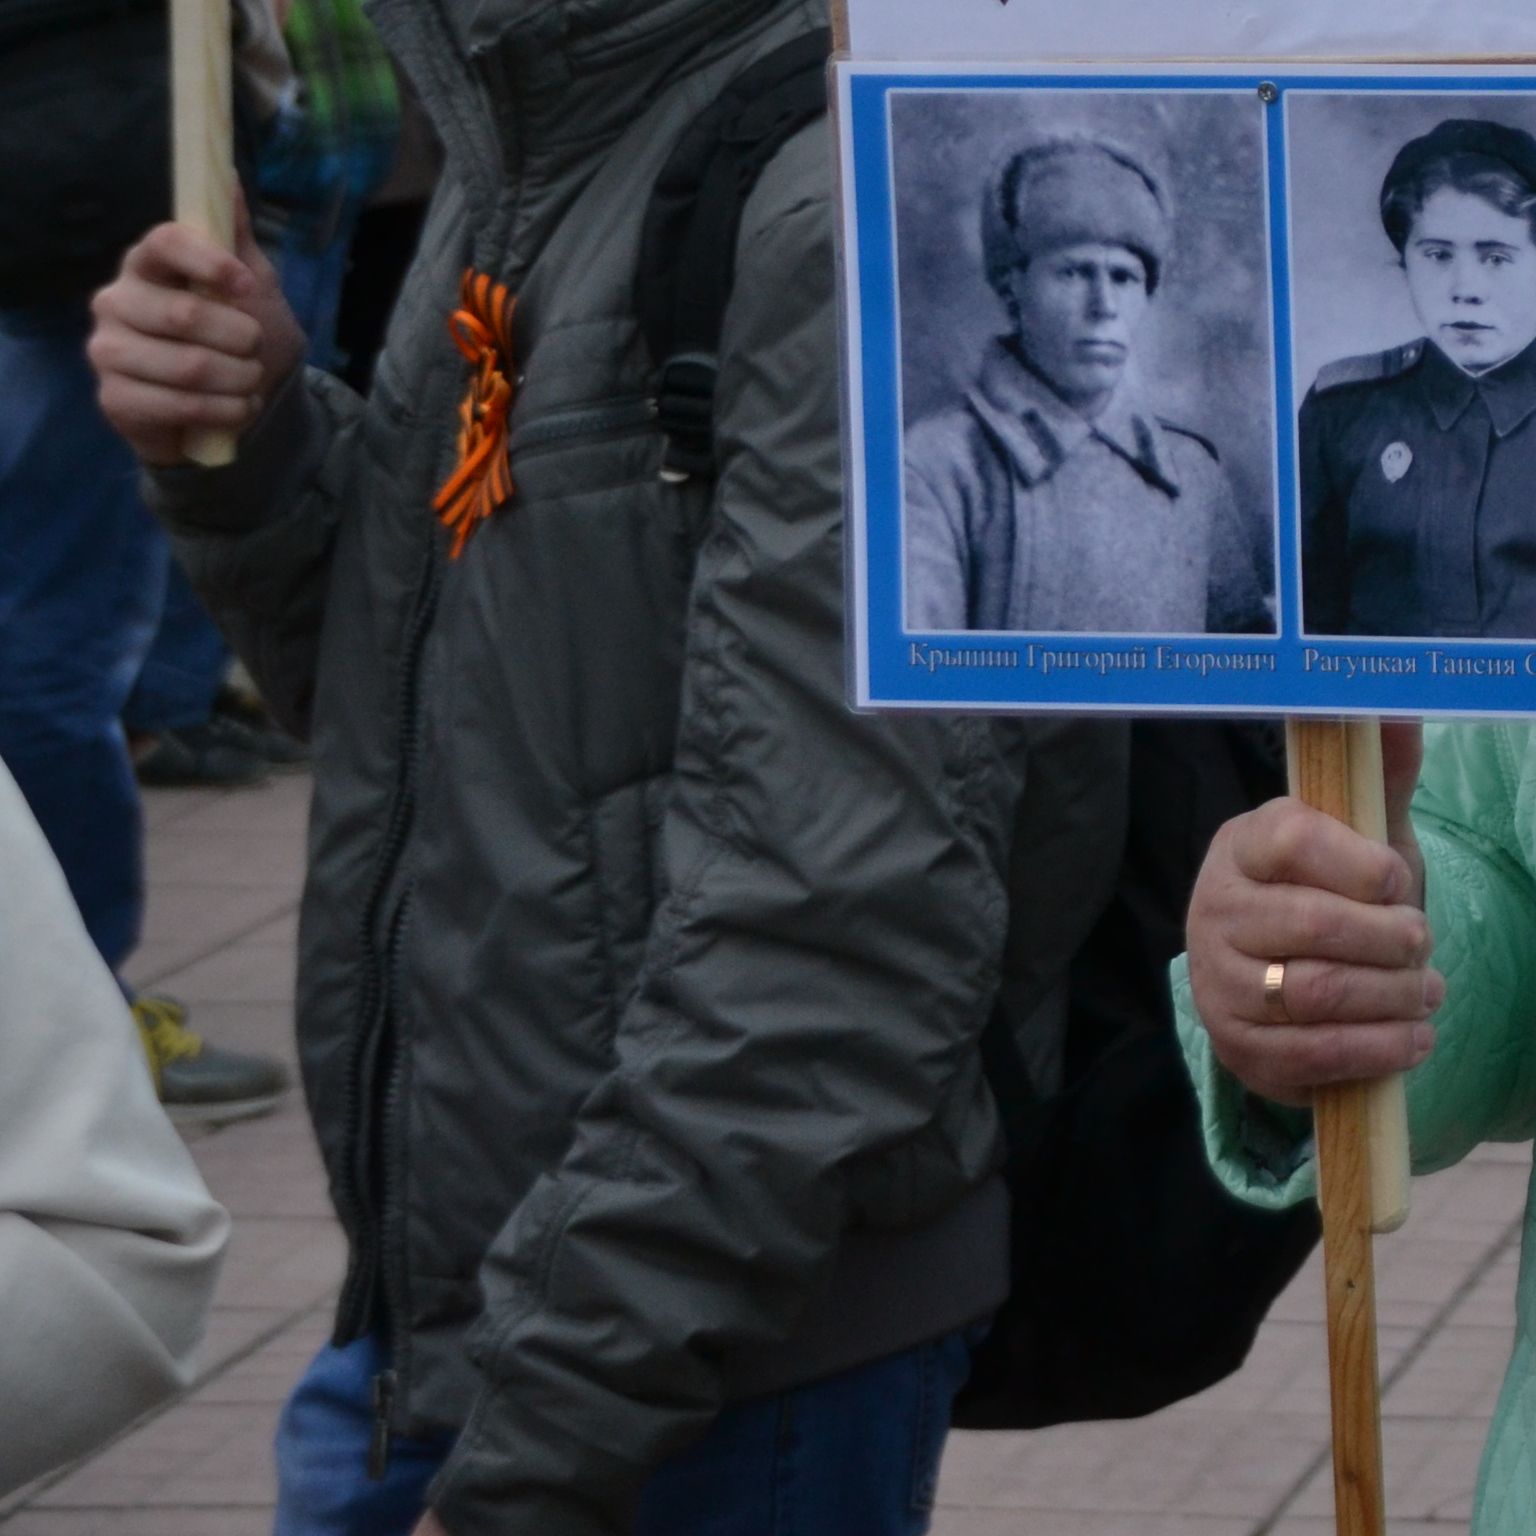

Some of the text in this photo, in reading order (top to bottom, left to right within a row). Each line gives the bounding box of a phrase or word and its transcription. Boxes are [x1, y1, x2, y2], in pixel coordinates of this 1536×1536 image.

[1027, 644, 1147, 675] Григорий
[1155, 645, 1277, 676] Егорович
[1303, 648, 1418, 678] Рагуцкая
[1425, 651, 1516, 676] Таисия
